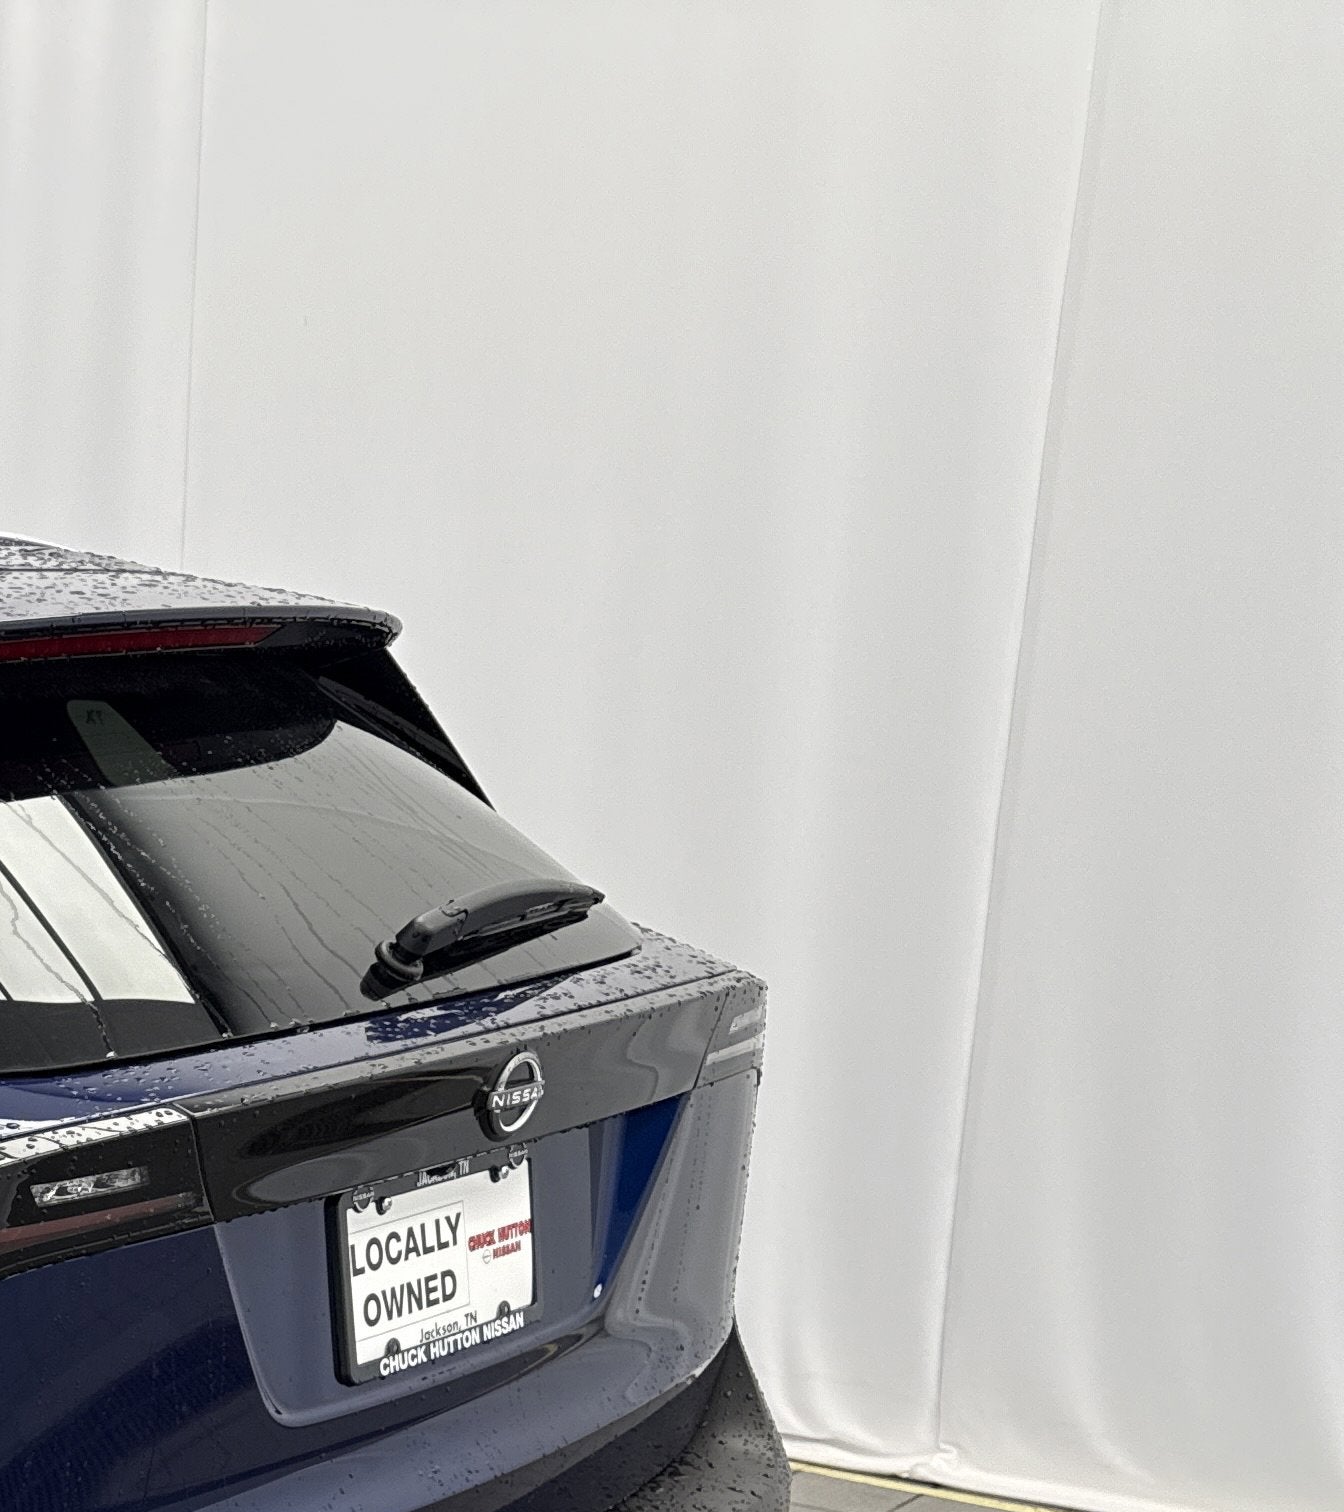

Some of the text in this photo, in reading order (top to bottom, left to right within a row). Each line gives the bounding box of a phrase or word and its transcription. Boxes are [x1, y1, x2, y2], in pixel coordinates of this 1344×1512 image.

[350, 1212, 461, 1277] LOCALLY
[363, 1269, 457, 1327] OWNED
[464, 1310, 477, 1327] TN
[379, 1311, 524, 1376] CHUCK HUTTON NISSAN
